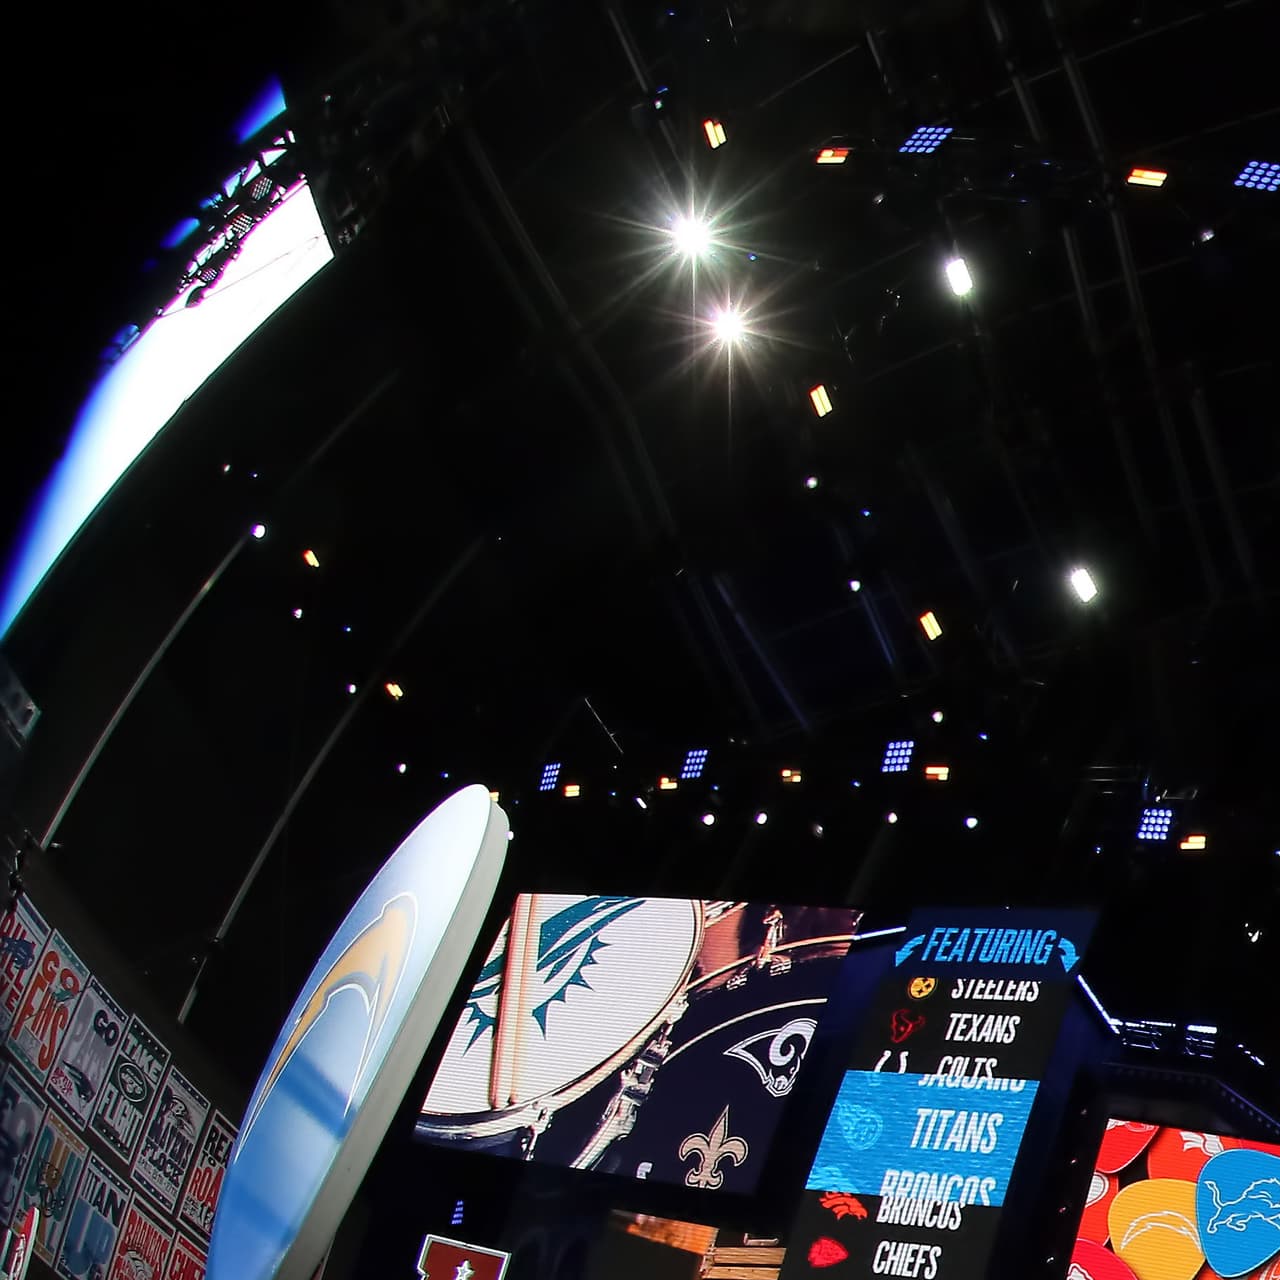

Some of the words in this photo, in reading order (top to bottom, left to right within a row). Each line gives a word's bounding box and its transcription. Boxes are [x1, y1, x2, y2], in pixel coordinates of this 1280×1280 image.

[921, 927, 1058, 965] FEATURING
[42, 951, 80, 996] GO
[12, 973, 70, 1071] FINS
[93, 1009, 120, 1047] GO
[944, 1012, 1021, 1044] TEXANS
[122, 1031, 163, 1083] TAKE
[99, 1083, 146, 1151] FLIGHT
[909, 1107, 1005, 1154] TITANS
[81, 1166, 126, 1228] TITAN
[880, 1167, 998, 1208] BRONCOS
[875, 1194, 966, 1231] BRONCOS
[871, 1240, 943, 1280] CHIEFS
